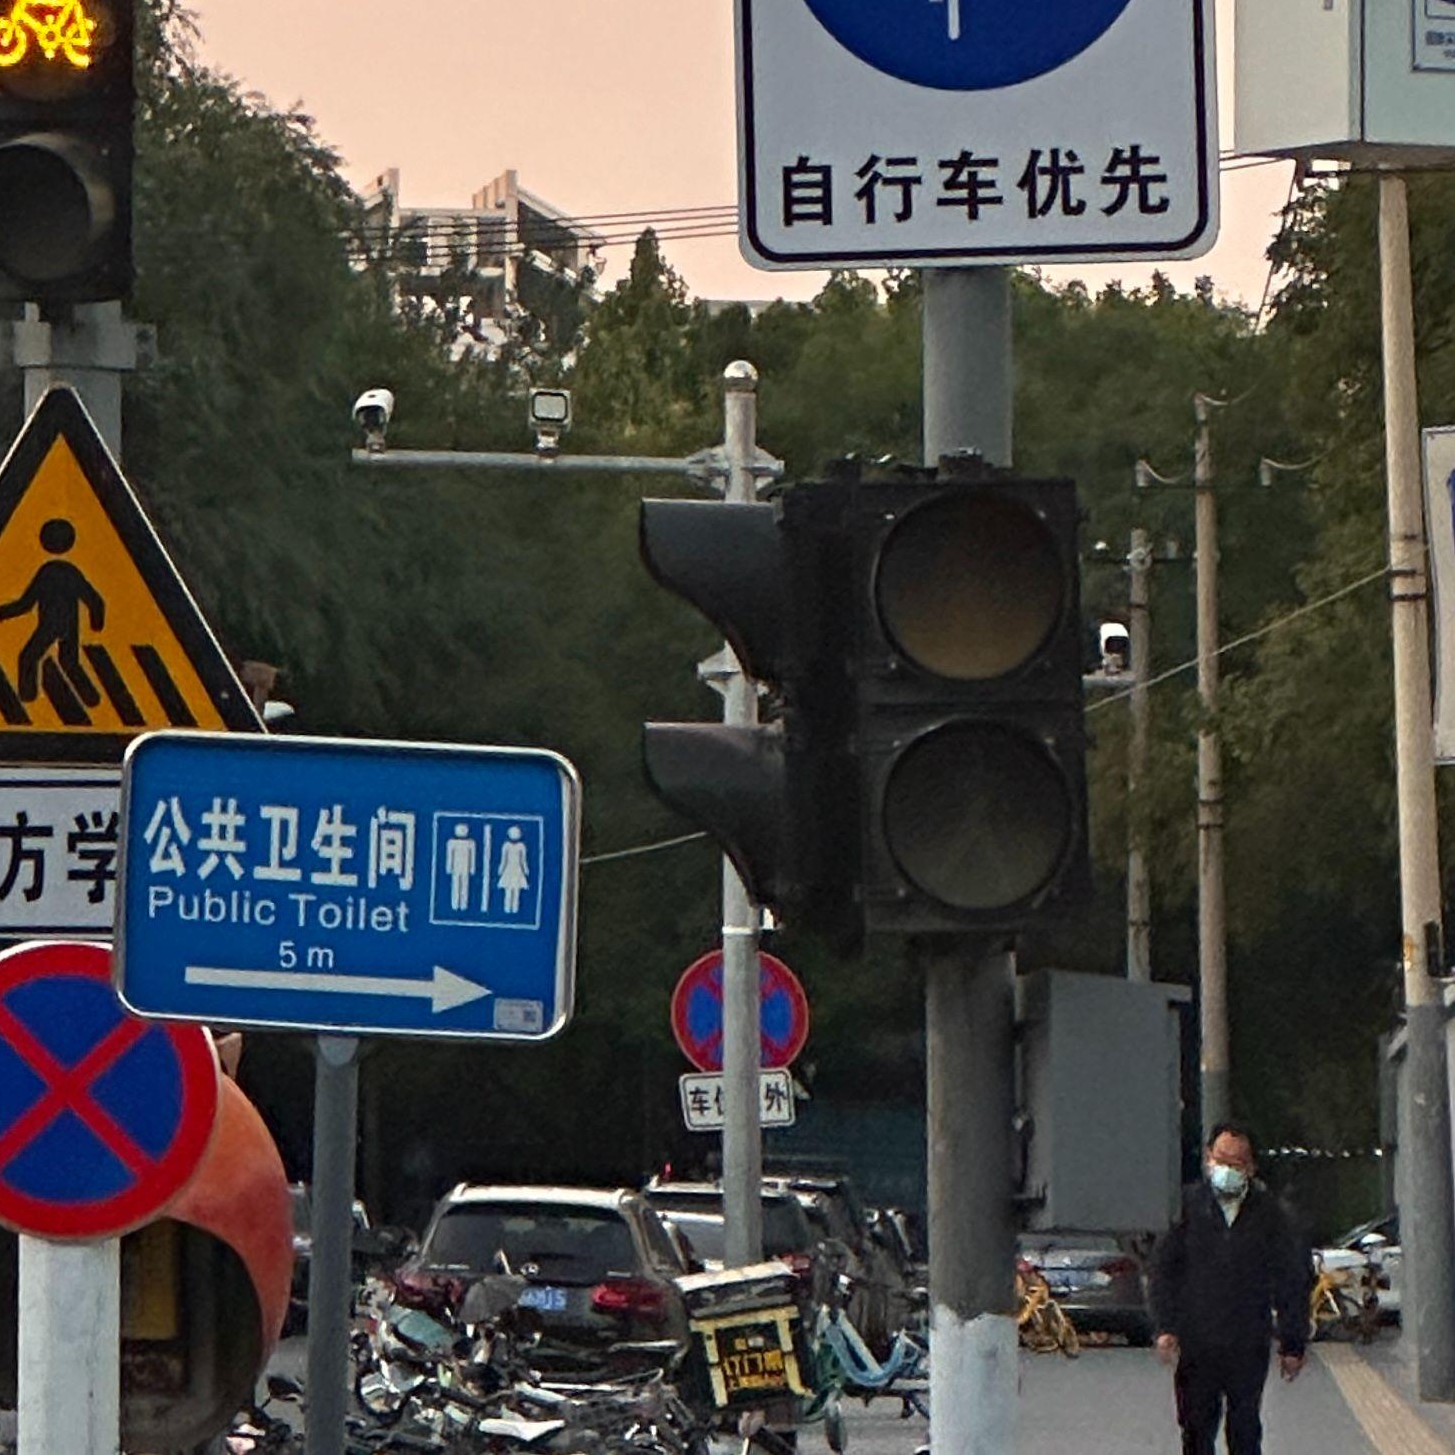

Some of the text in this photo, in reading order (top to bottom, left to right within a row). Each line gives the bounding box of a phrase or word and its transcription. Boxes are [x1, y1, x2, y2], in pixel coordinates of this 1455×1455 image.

[782, 144, 1170, 226] 自行车优先
[144, 796, 415, 891] 公共卫生间
[148, 885, 410, 933] Public Toilet
